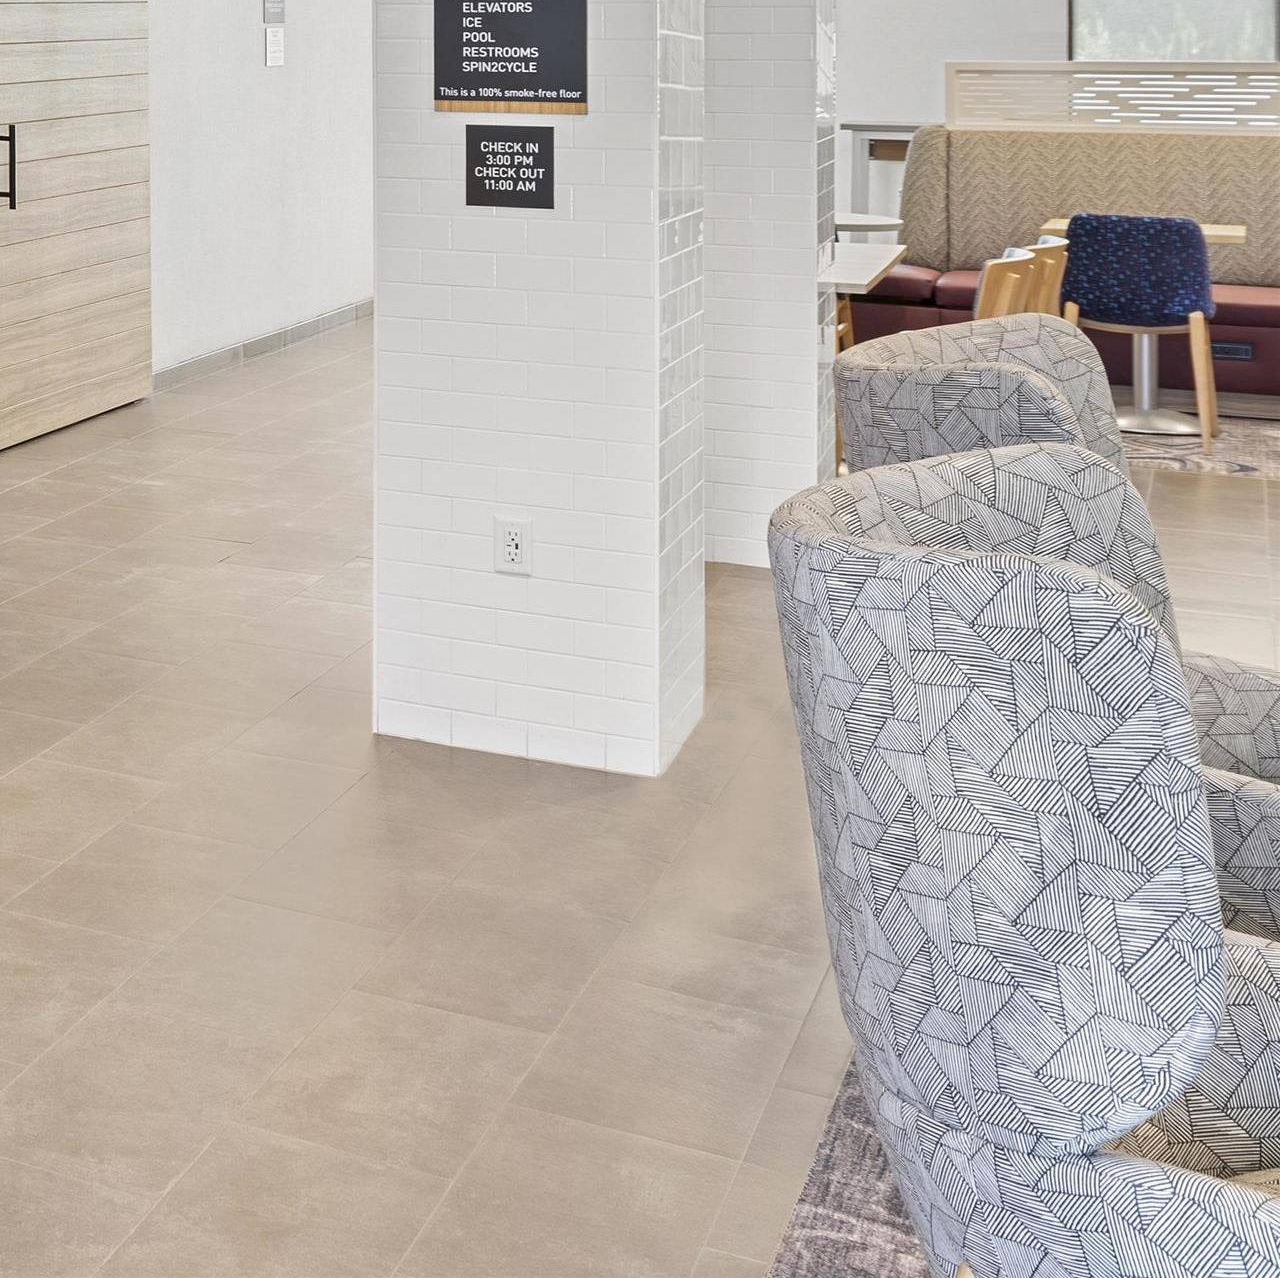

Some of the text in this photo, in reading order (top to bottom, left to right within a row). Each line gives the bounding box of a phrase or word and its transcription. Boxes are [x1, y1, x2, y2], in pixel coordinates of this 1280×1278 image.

[462, 2, 532, 13] ELEVATORS
[462, 17, 482, 28] ICE
[463, 32, 496, 43] POOL
[463, 47, 539, 58] RESTROOMS
[462, 61, 537, 73] SPIN2CYCLE
[439, 87, 582, 99] This is a 100% smoke-free floor
[480, 141, 539, 154] CHECK IN
[486, 154, 533, 166] 3:00 PM
[474, 167, 545, 179] CHECK OUT
[483, 179, 536, 192] 11:00 AM
